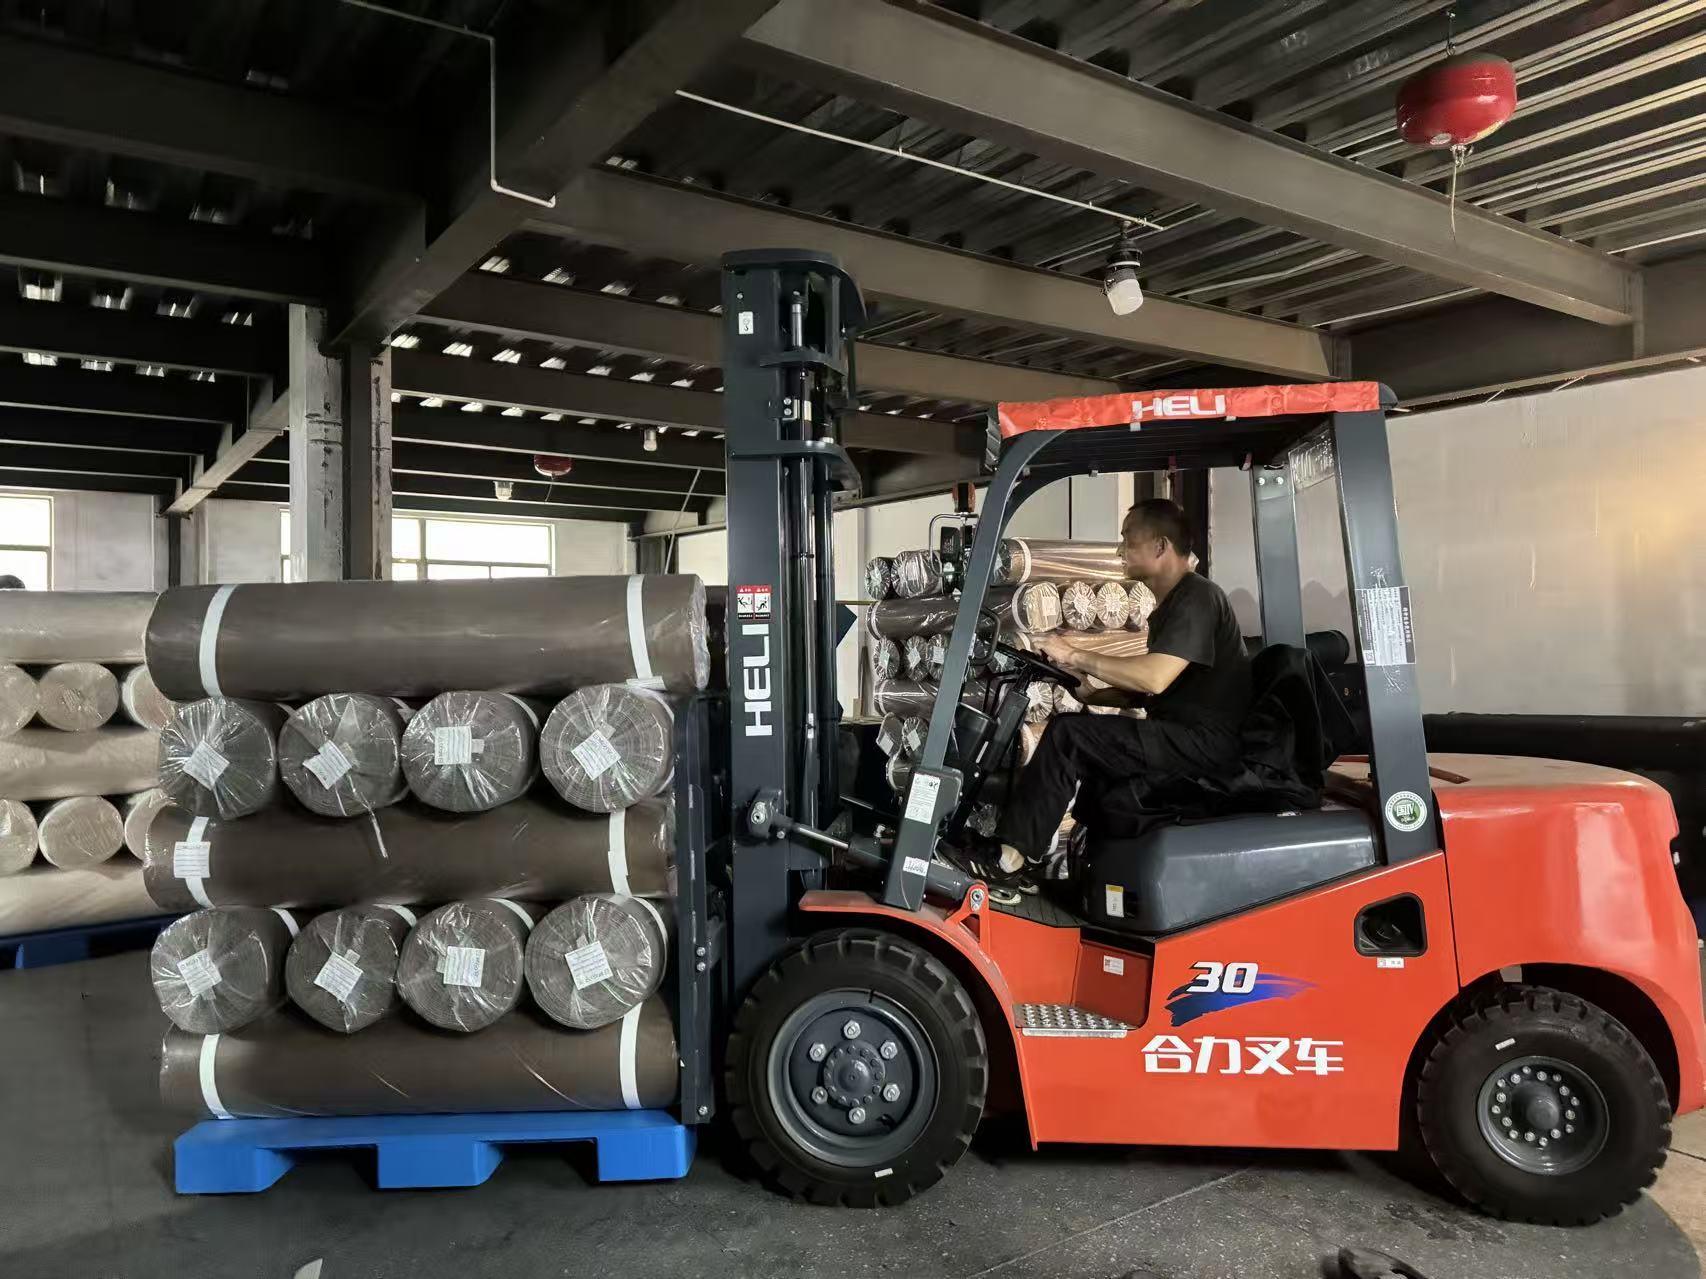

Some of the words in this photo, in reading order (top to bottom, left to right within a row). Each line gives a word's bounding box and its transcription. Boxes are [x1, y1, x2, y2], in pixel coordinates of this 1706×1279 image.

[1132, 395, 1226, 420] HELI
[742, 623, 773, 737] HELI
[1186, 961, 1259, 994] 30
[1141, 1035, 1344, 1075] 合力叉车
